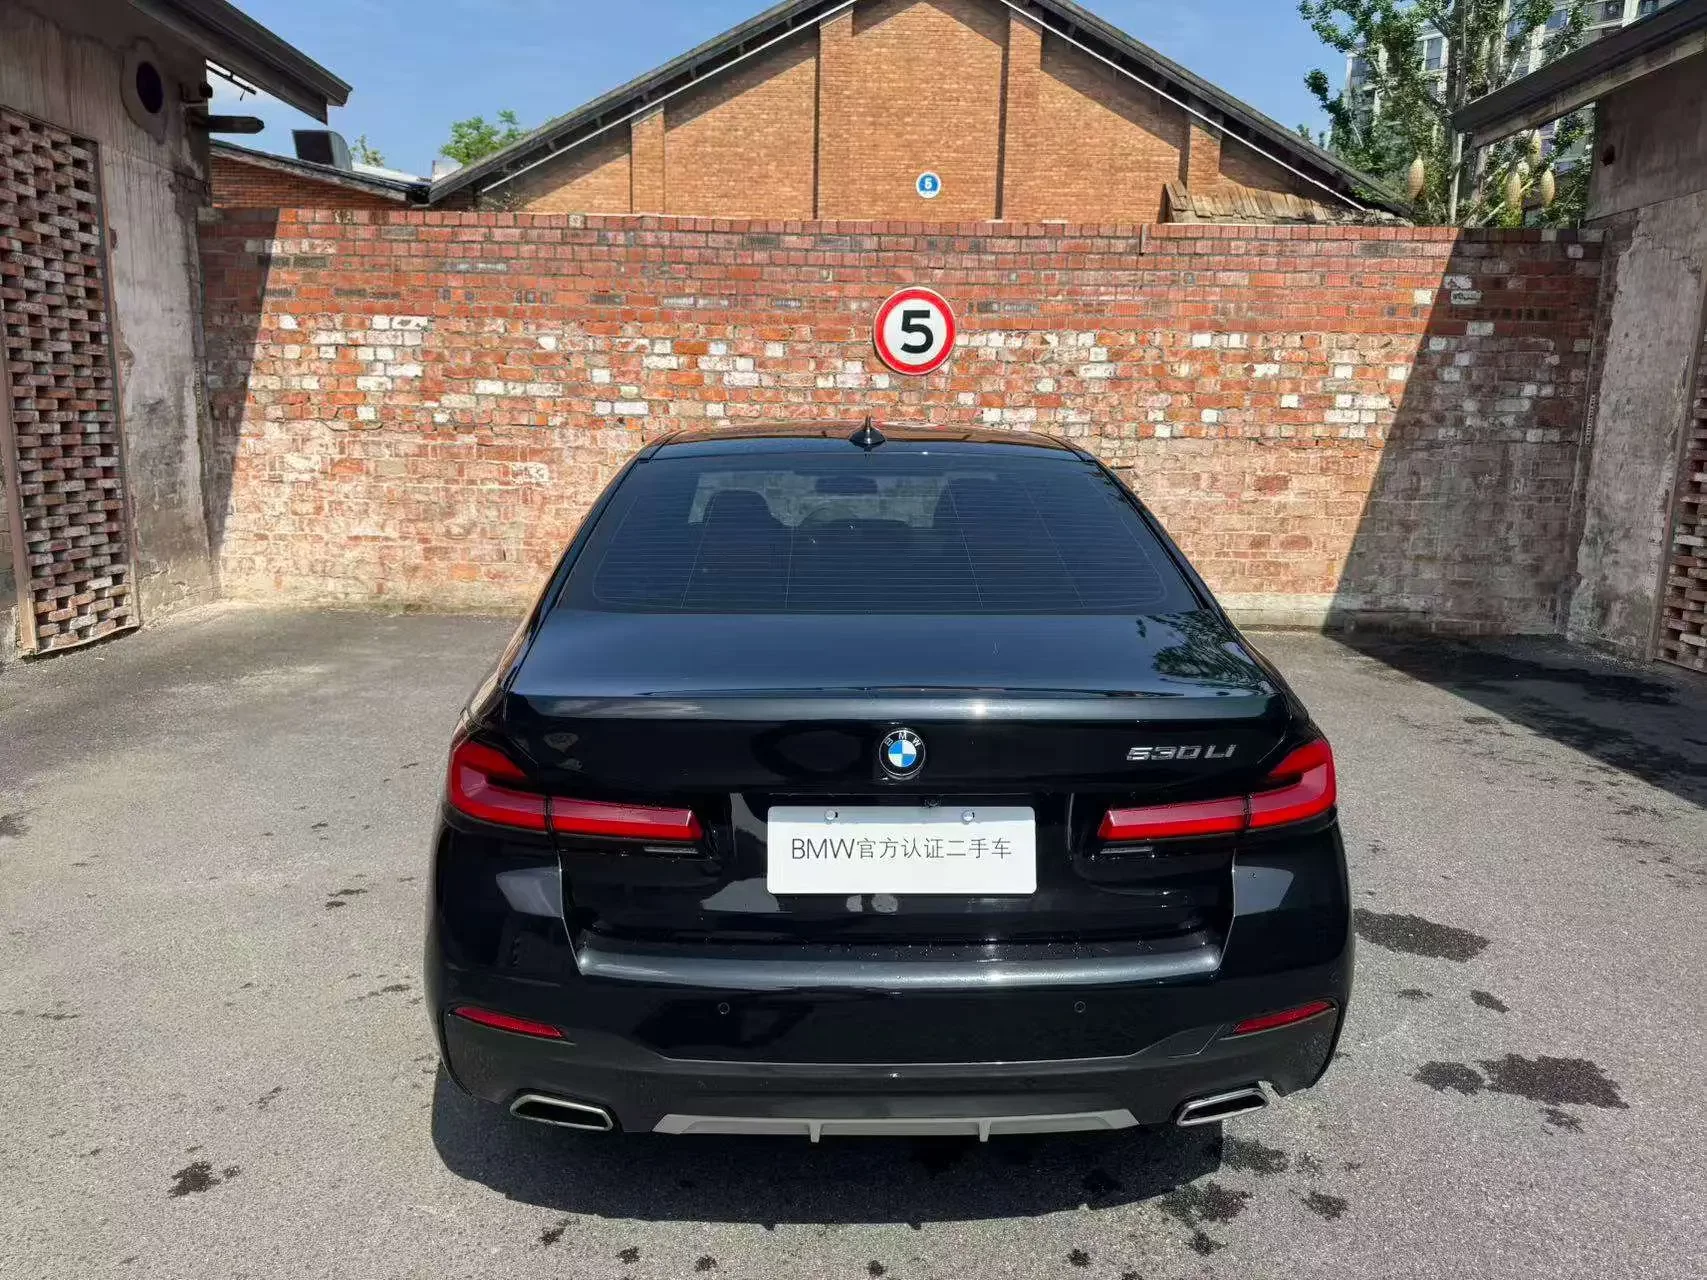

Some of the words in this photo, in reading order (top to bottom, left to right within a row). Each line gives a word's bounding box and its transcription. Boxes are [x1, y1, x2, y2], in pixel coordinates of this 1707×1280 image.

[901, 310, 934, 354] 5
[885, 732, 921, 747] BMW
[791, 837, 1012, 860] BMW官方认证二手车
